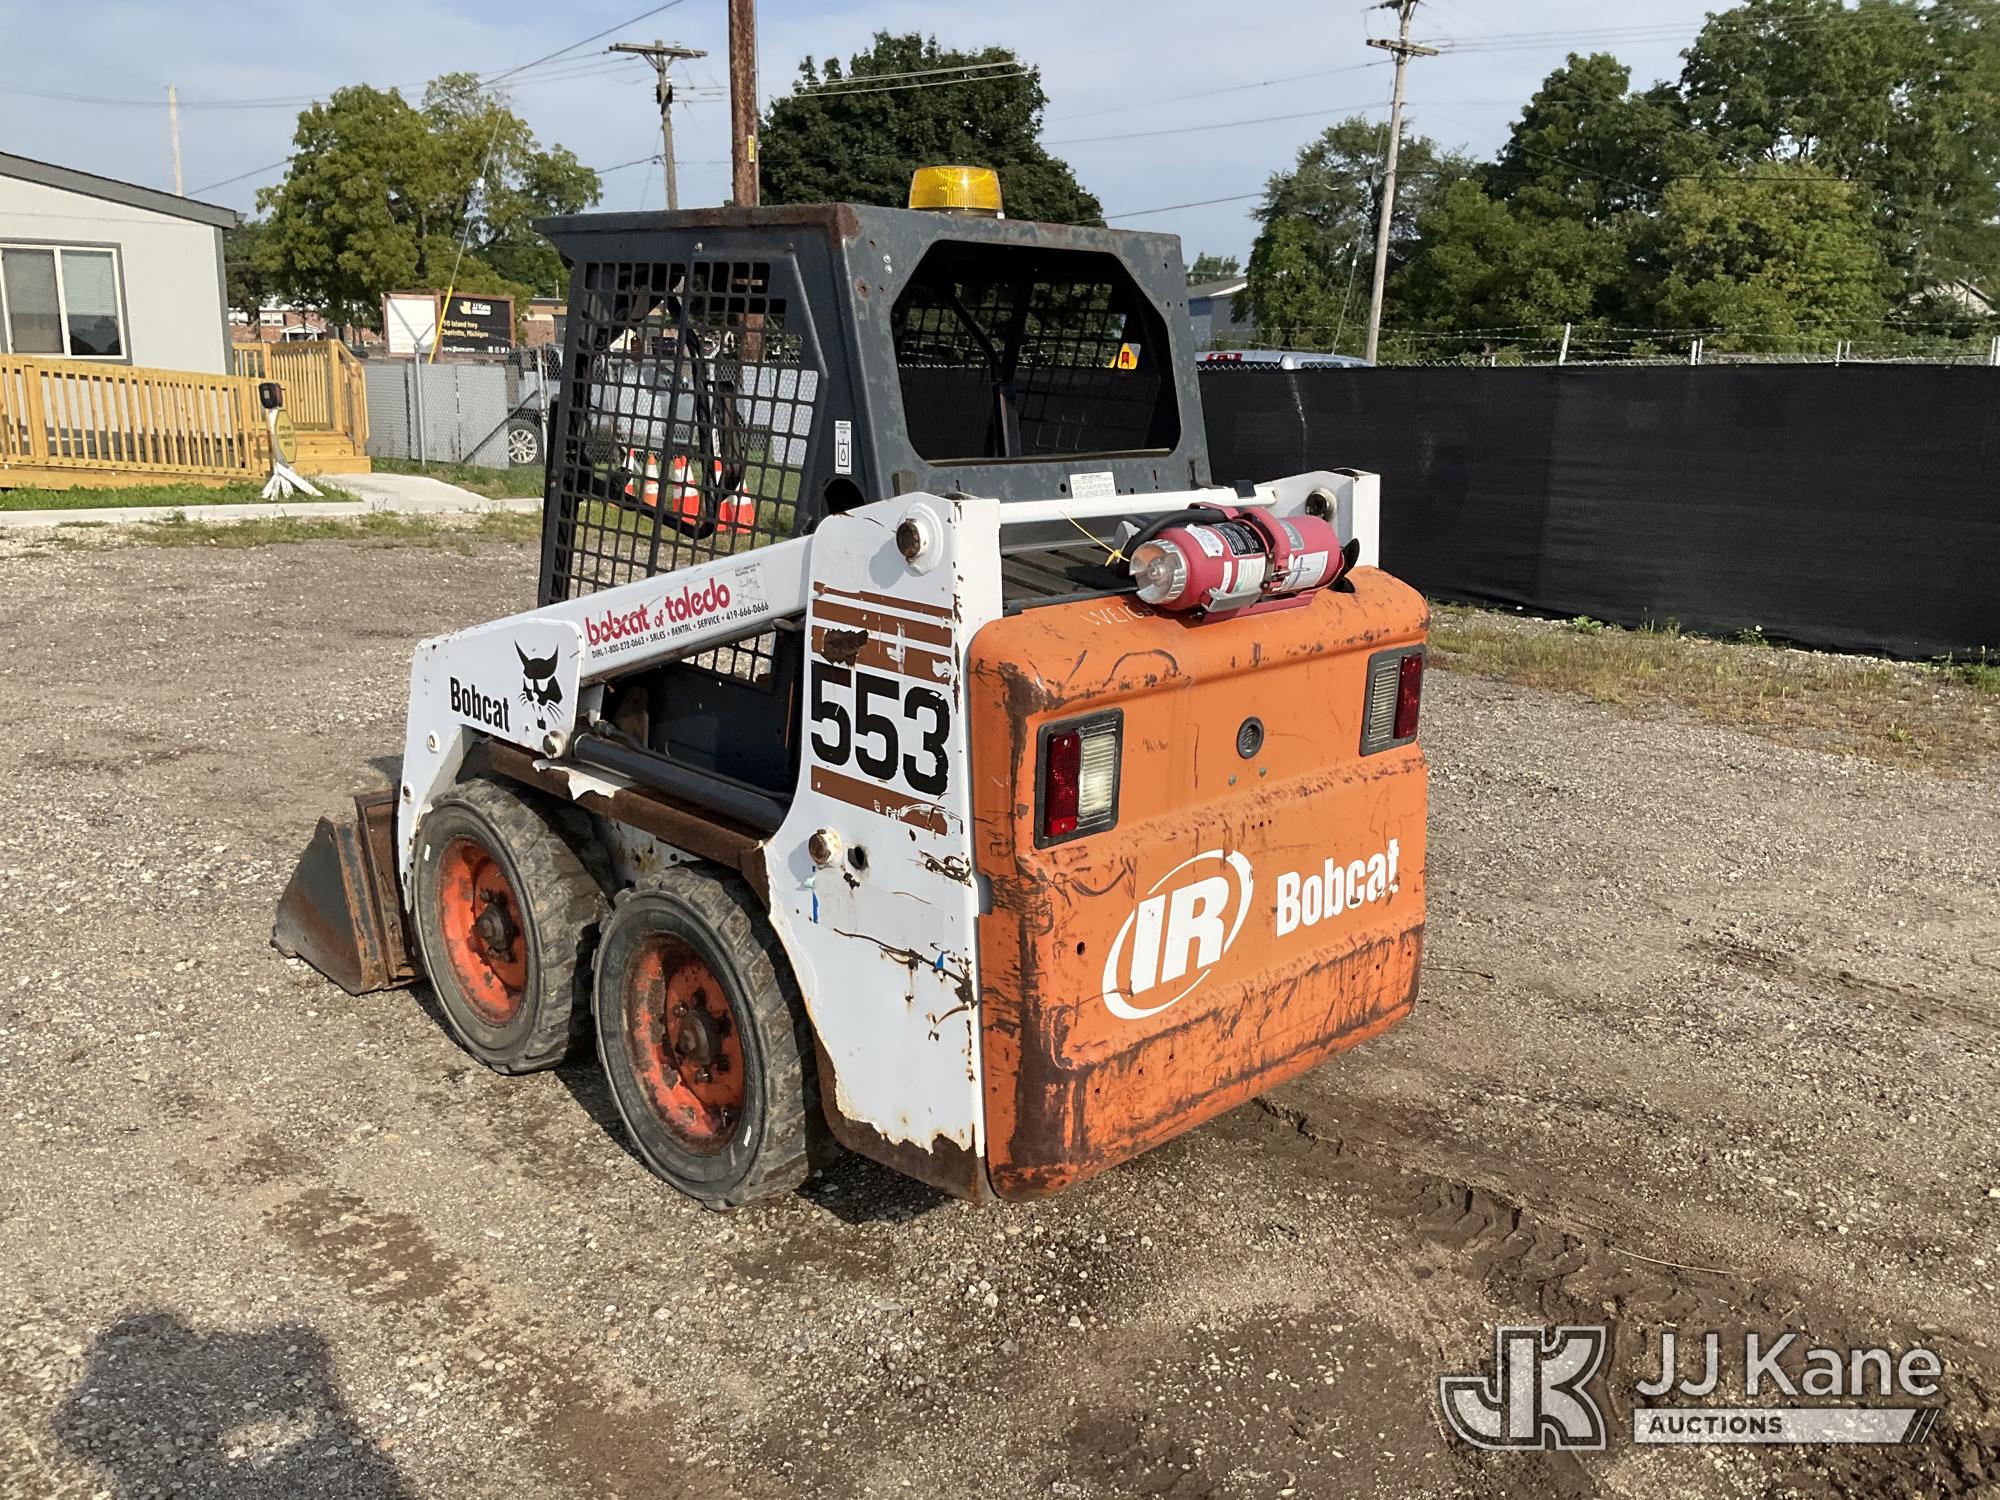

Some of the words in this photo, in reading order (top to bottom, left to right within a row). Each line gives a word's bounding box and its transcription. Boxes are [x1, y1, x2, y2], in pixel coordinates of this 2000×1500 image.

[649, 630, 666, 643] SALES
[671, 622, 693, 637] RENTAL
[696, 614, 721, 630] SERVICE
[654, 609, 664, 628] of
[664, 577, 731, 623] toledo
[449, 676, 510, 733] Bobcat
[810, 659, 951, 796] 553
[1276, 838, 1400, 938] Bobcat
[1130, 876, 1229, 997] IR
